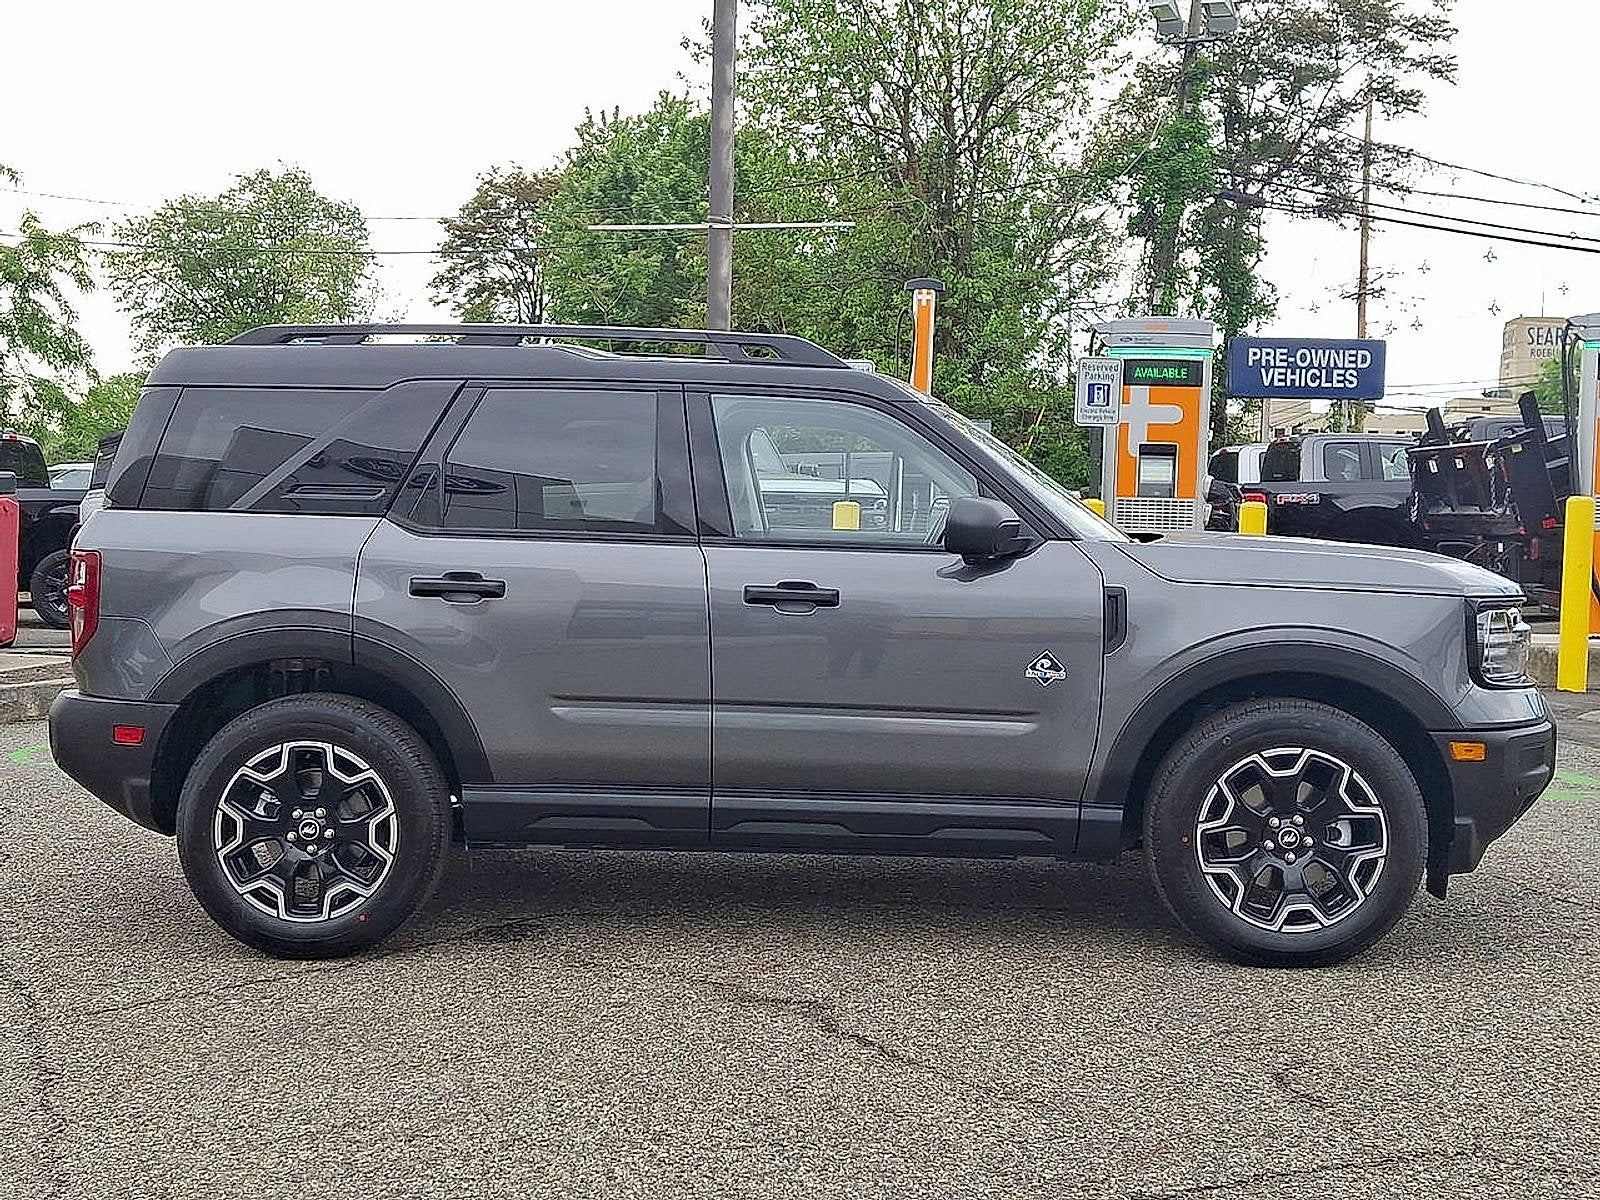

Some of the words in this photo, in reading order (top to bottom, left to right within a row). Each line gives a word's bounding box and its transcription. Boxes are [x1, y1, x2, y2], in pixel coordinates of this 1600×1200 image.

[1527, 327, 1572, 345] SEARS
[1248, 347, 1372, 369] PRE-OWNED
[1530, 348, 1560, 357] ROEBU
[1081, 362, 1119, 372] Reserved
[1133, 367, 1189, 379] AVAILABLE
[1084, 372, 1115, 383] Parking
[1260, 368, 1359, 389] VEHICLES
